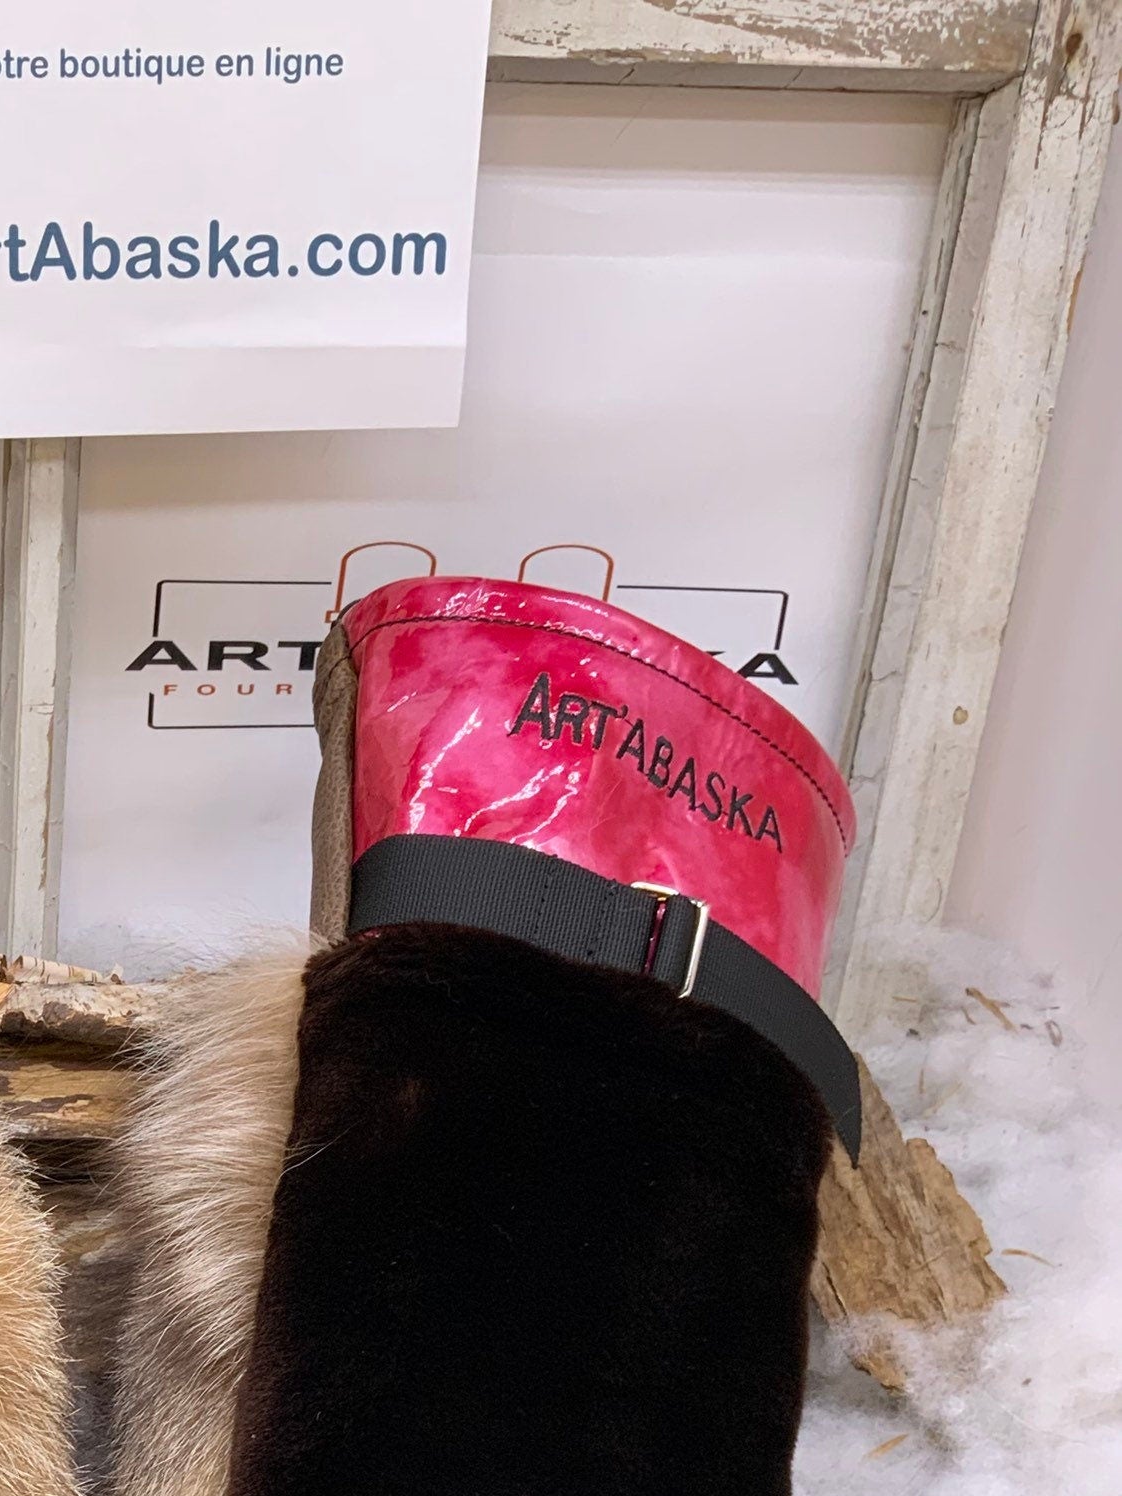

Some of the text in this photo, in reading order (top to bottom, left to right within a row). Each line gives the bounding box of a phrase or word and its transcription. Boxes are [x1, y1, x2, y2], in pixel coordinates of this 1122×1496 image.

[59, 47, 206, 85] boutique
[214, 53, 255, 77] en
[265, 46, 345, 84] ligne
[506, 671, 783, 854] ART'ABASKA
